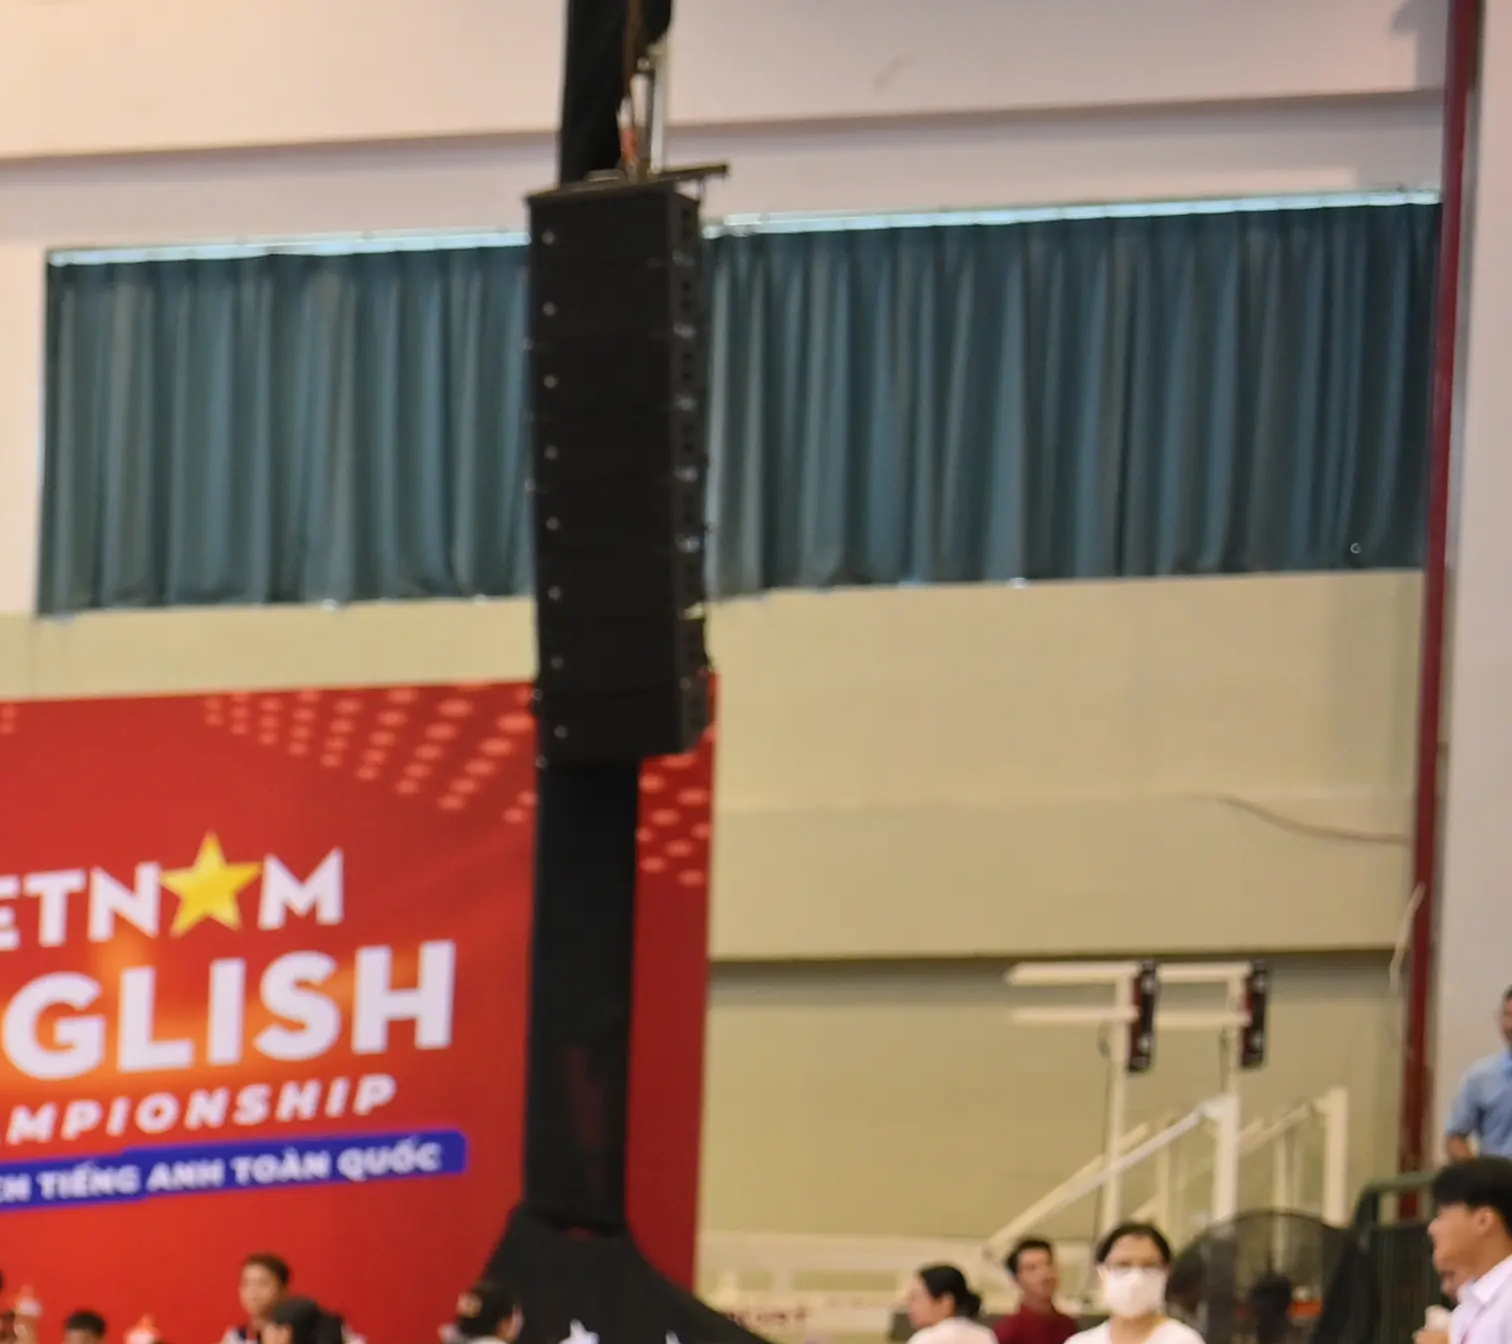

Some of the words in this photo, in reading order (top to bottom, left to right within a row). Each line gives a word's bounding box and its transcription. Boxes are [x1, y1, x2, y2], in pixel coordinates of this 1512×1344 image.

[38, 1149, 145, 1200] TIẾNG
[153, 1155, 228, 1193] ANH
[234, 1142, 332, 1188] TOÀN
[339, 1130, 438, 1178] QUỐC
